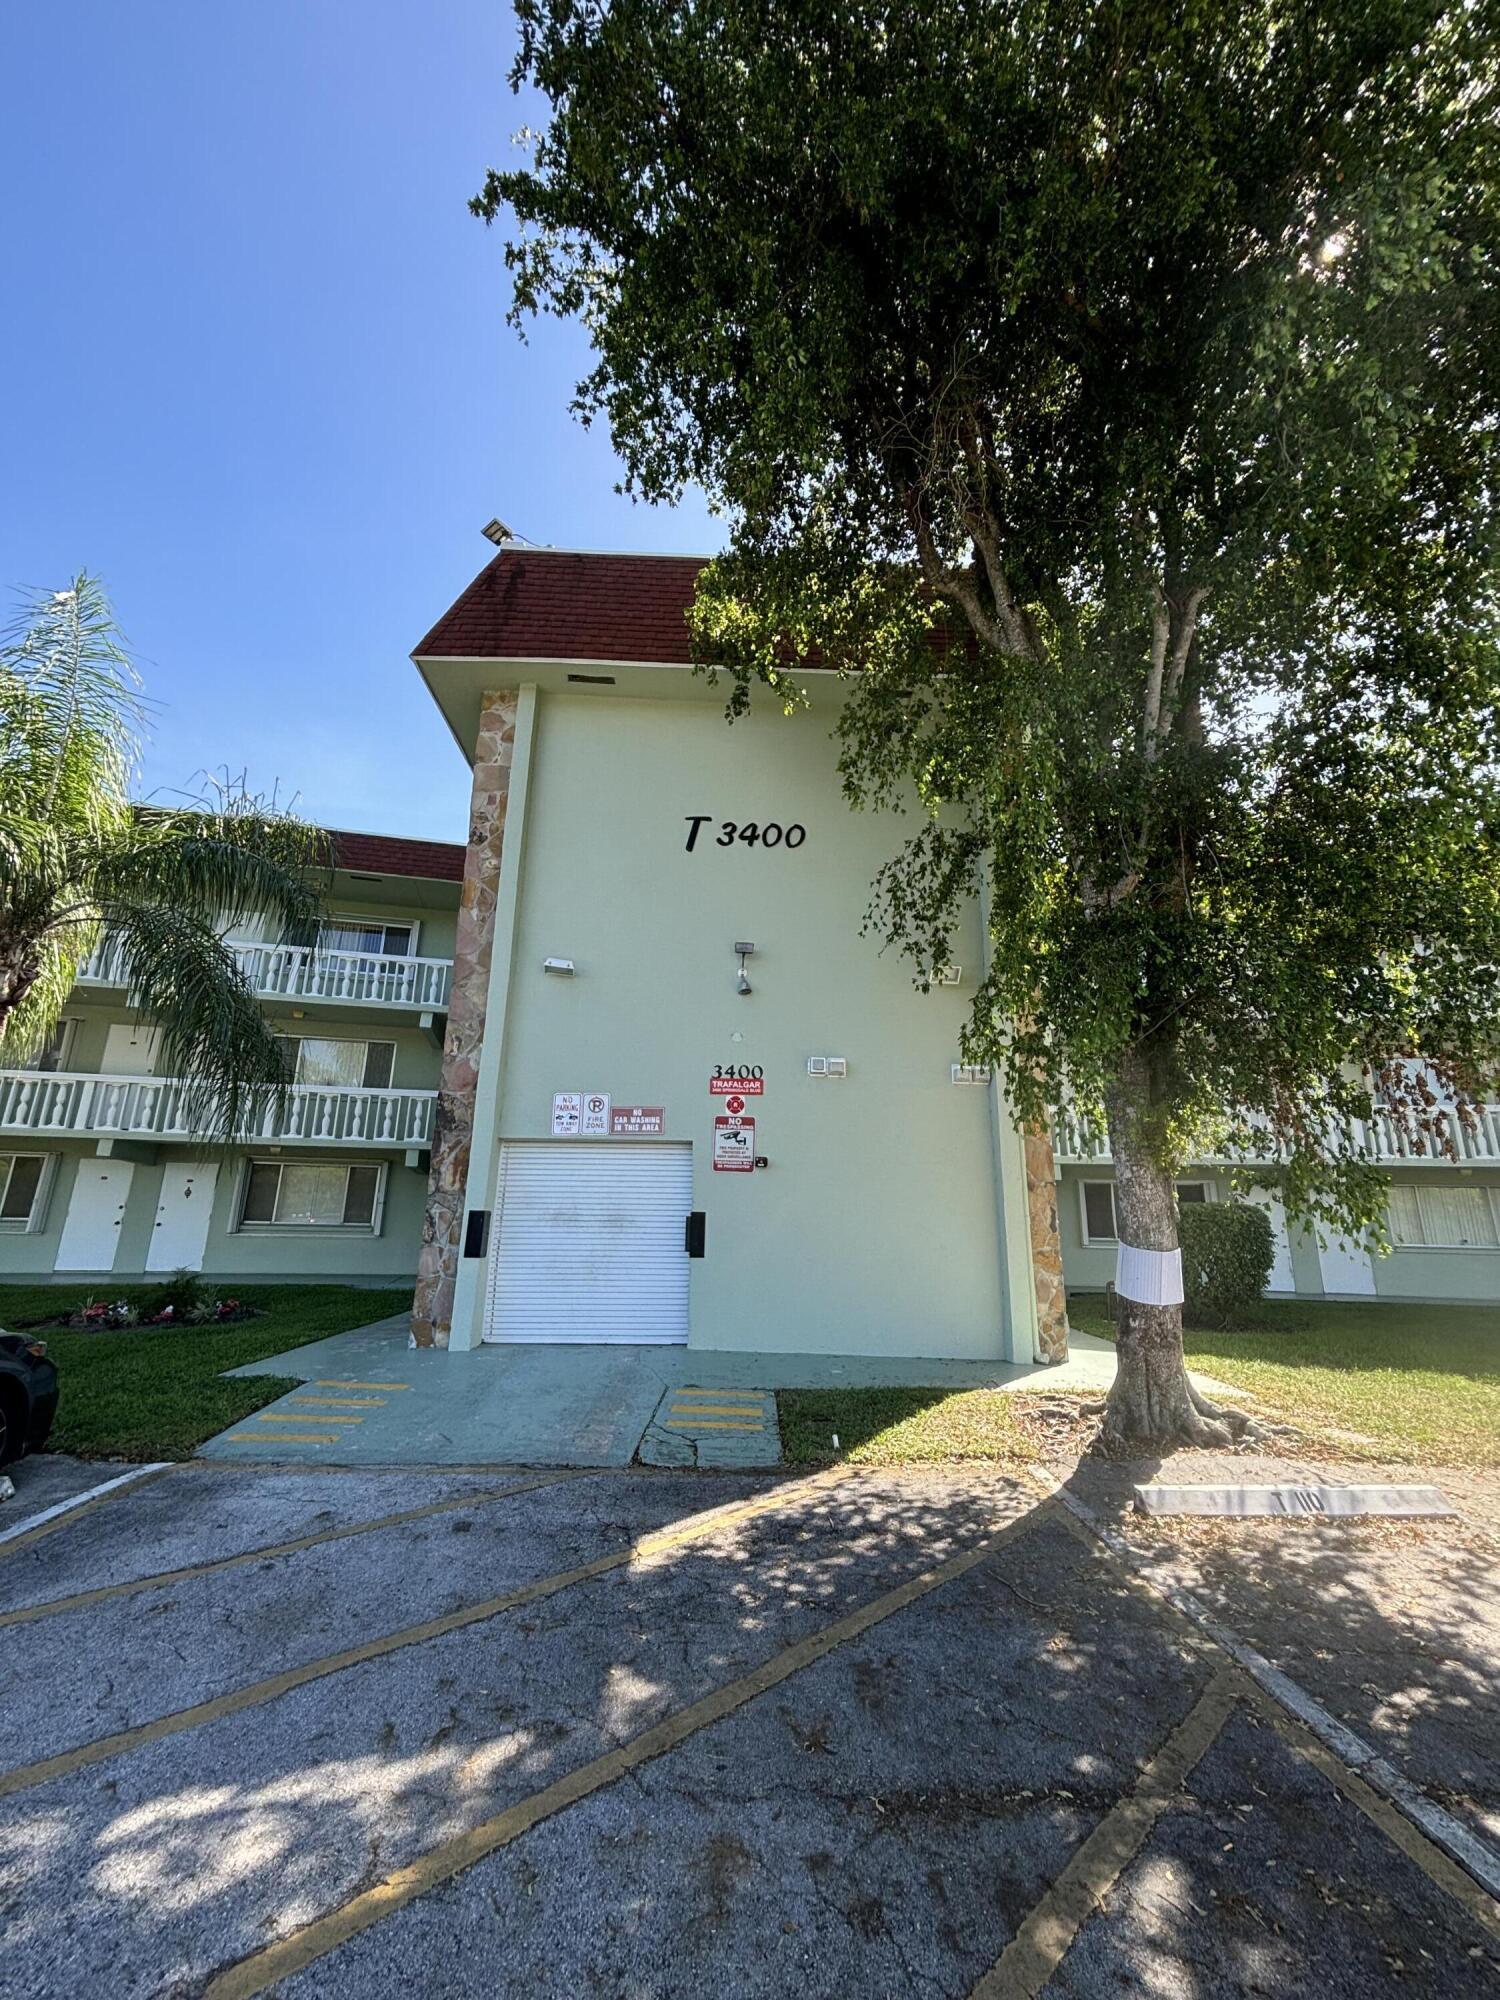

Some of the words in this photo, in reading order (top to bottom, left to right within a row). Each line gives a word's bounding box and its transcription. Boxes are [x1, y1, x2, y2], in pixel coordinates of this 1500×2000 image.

[685, 816, 712, 852] T
[716, 821, 806, 848] 3400
[711, 1064, 764, 1079] 3400
[712, 1080, 761, 1089] TRAFALGAR
[728, 1117, 742, 1125] NO
[1271, 1491, 1287, 1512] T
[1294, 1491, 1325, 1512] 110
